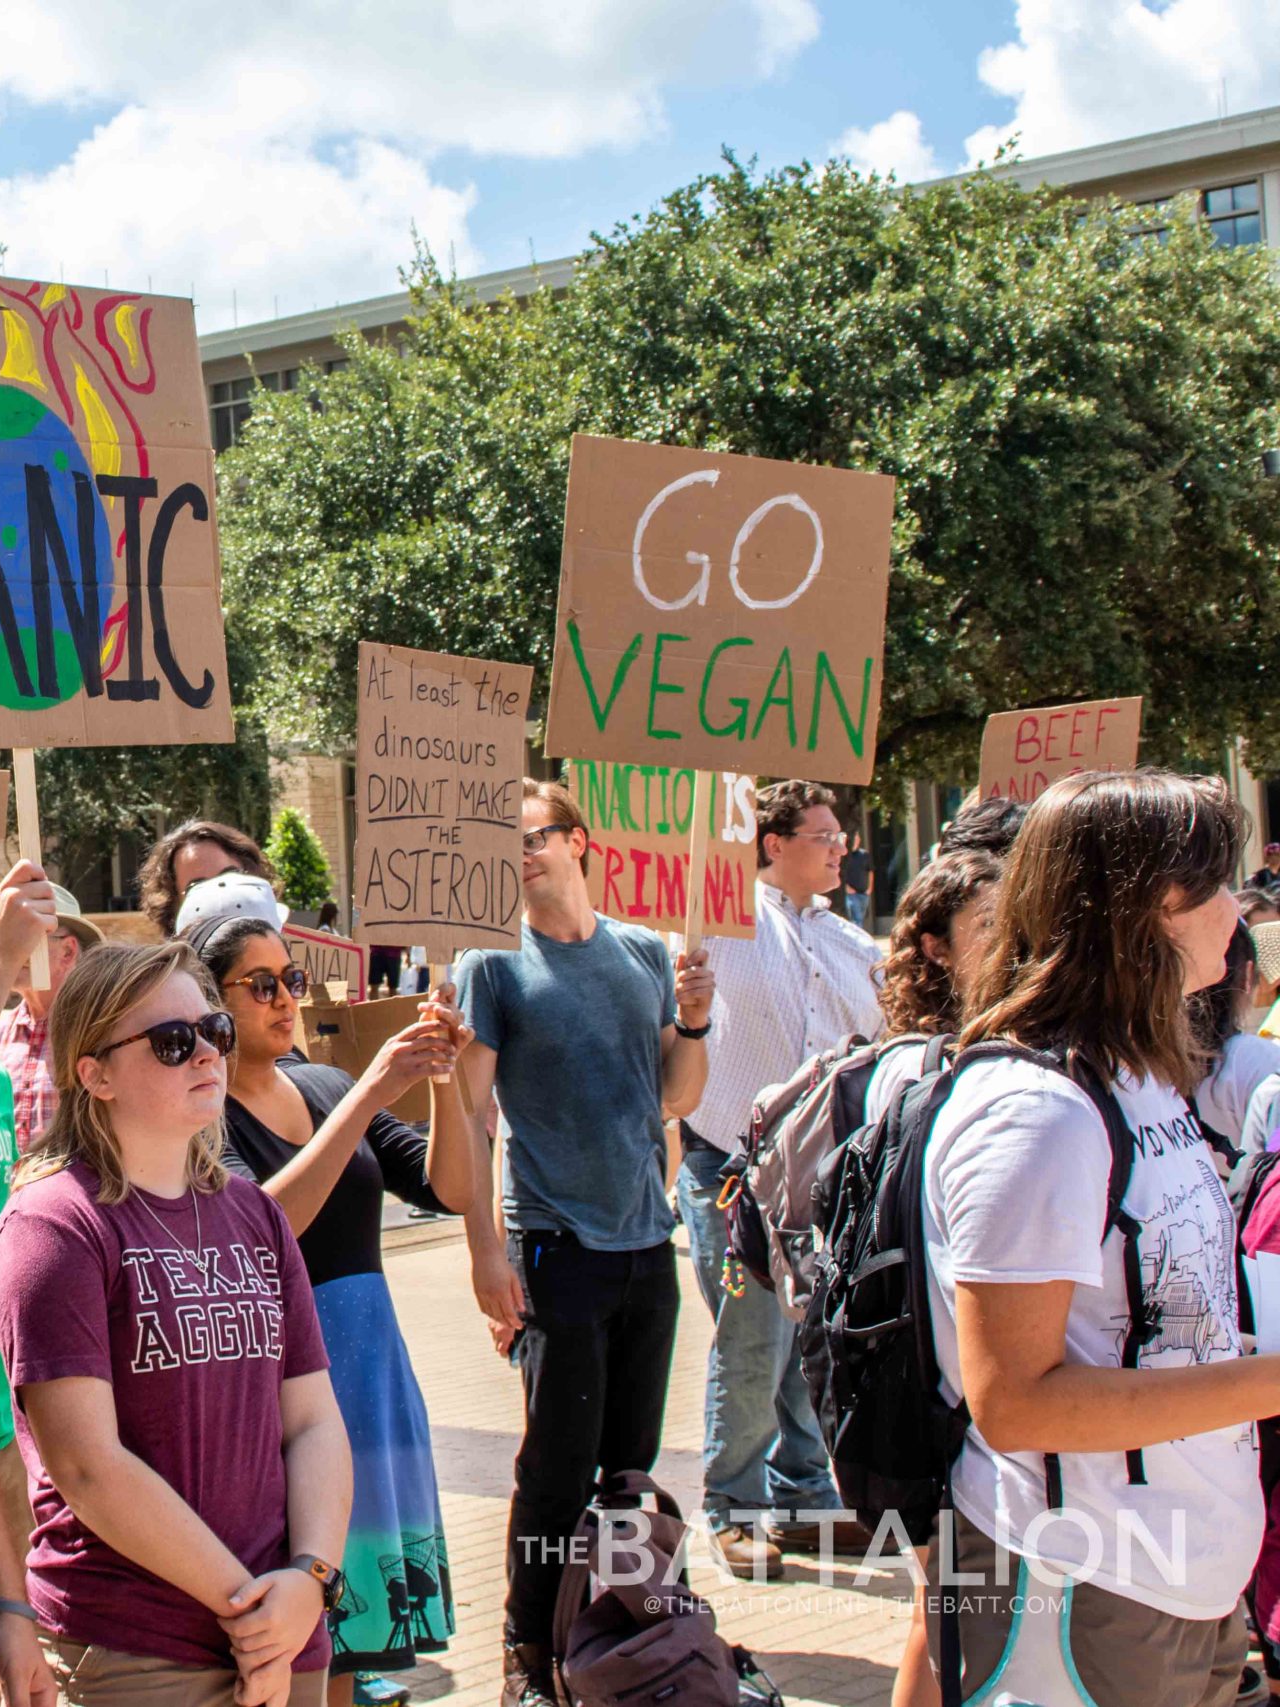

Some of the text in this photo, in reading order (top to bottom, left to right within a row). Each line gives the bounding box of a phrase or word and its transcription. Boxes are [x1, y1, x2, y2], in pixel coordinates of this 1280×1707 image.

[632, 468, 824, 611] GO
[367, 656, 519, 717] At least the
[566, 619, 874, 759] VEGAN
[375, 716, 496, 766] dinosaurs
[1015, 708, 1120, 764] BEEF
[368, 774, 518, 821] DIDN'T MAKE
[572, 759, 757, 844] INACTIO IS
[426, 826, 461, 845] THE
[364, 848, 519, 926] ASTEROID
[589, 840, 756, 927] RIMNAL
[121, 1244, 282, 1305] TEXAS
